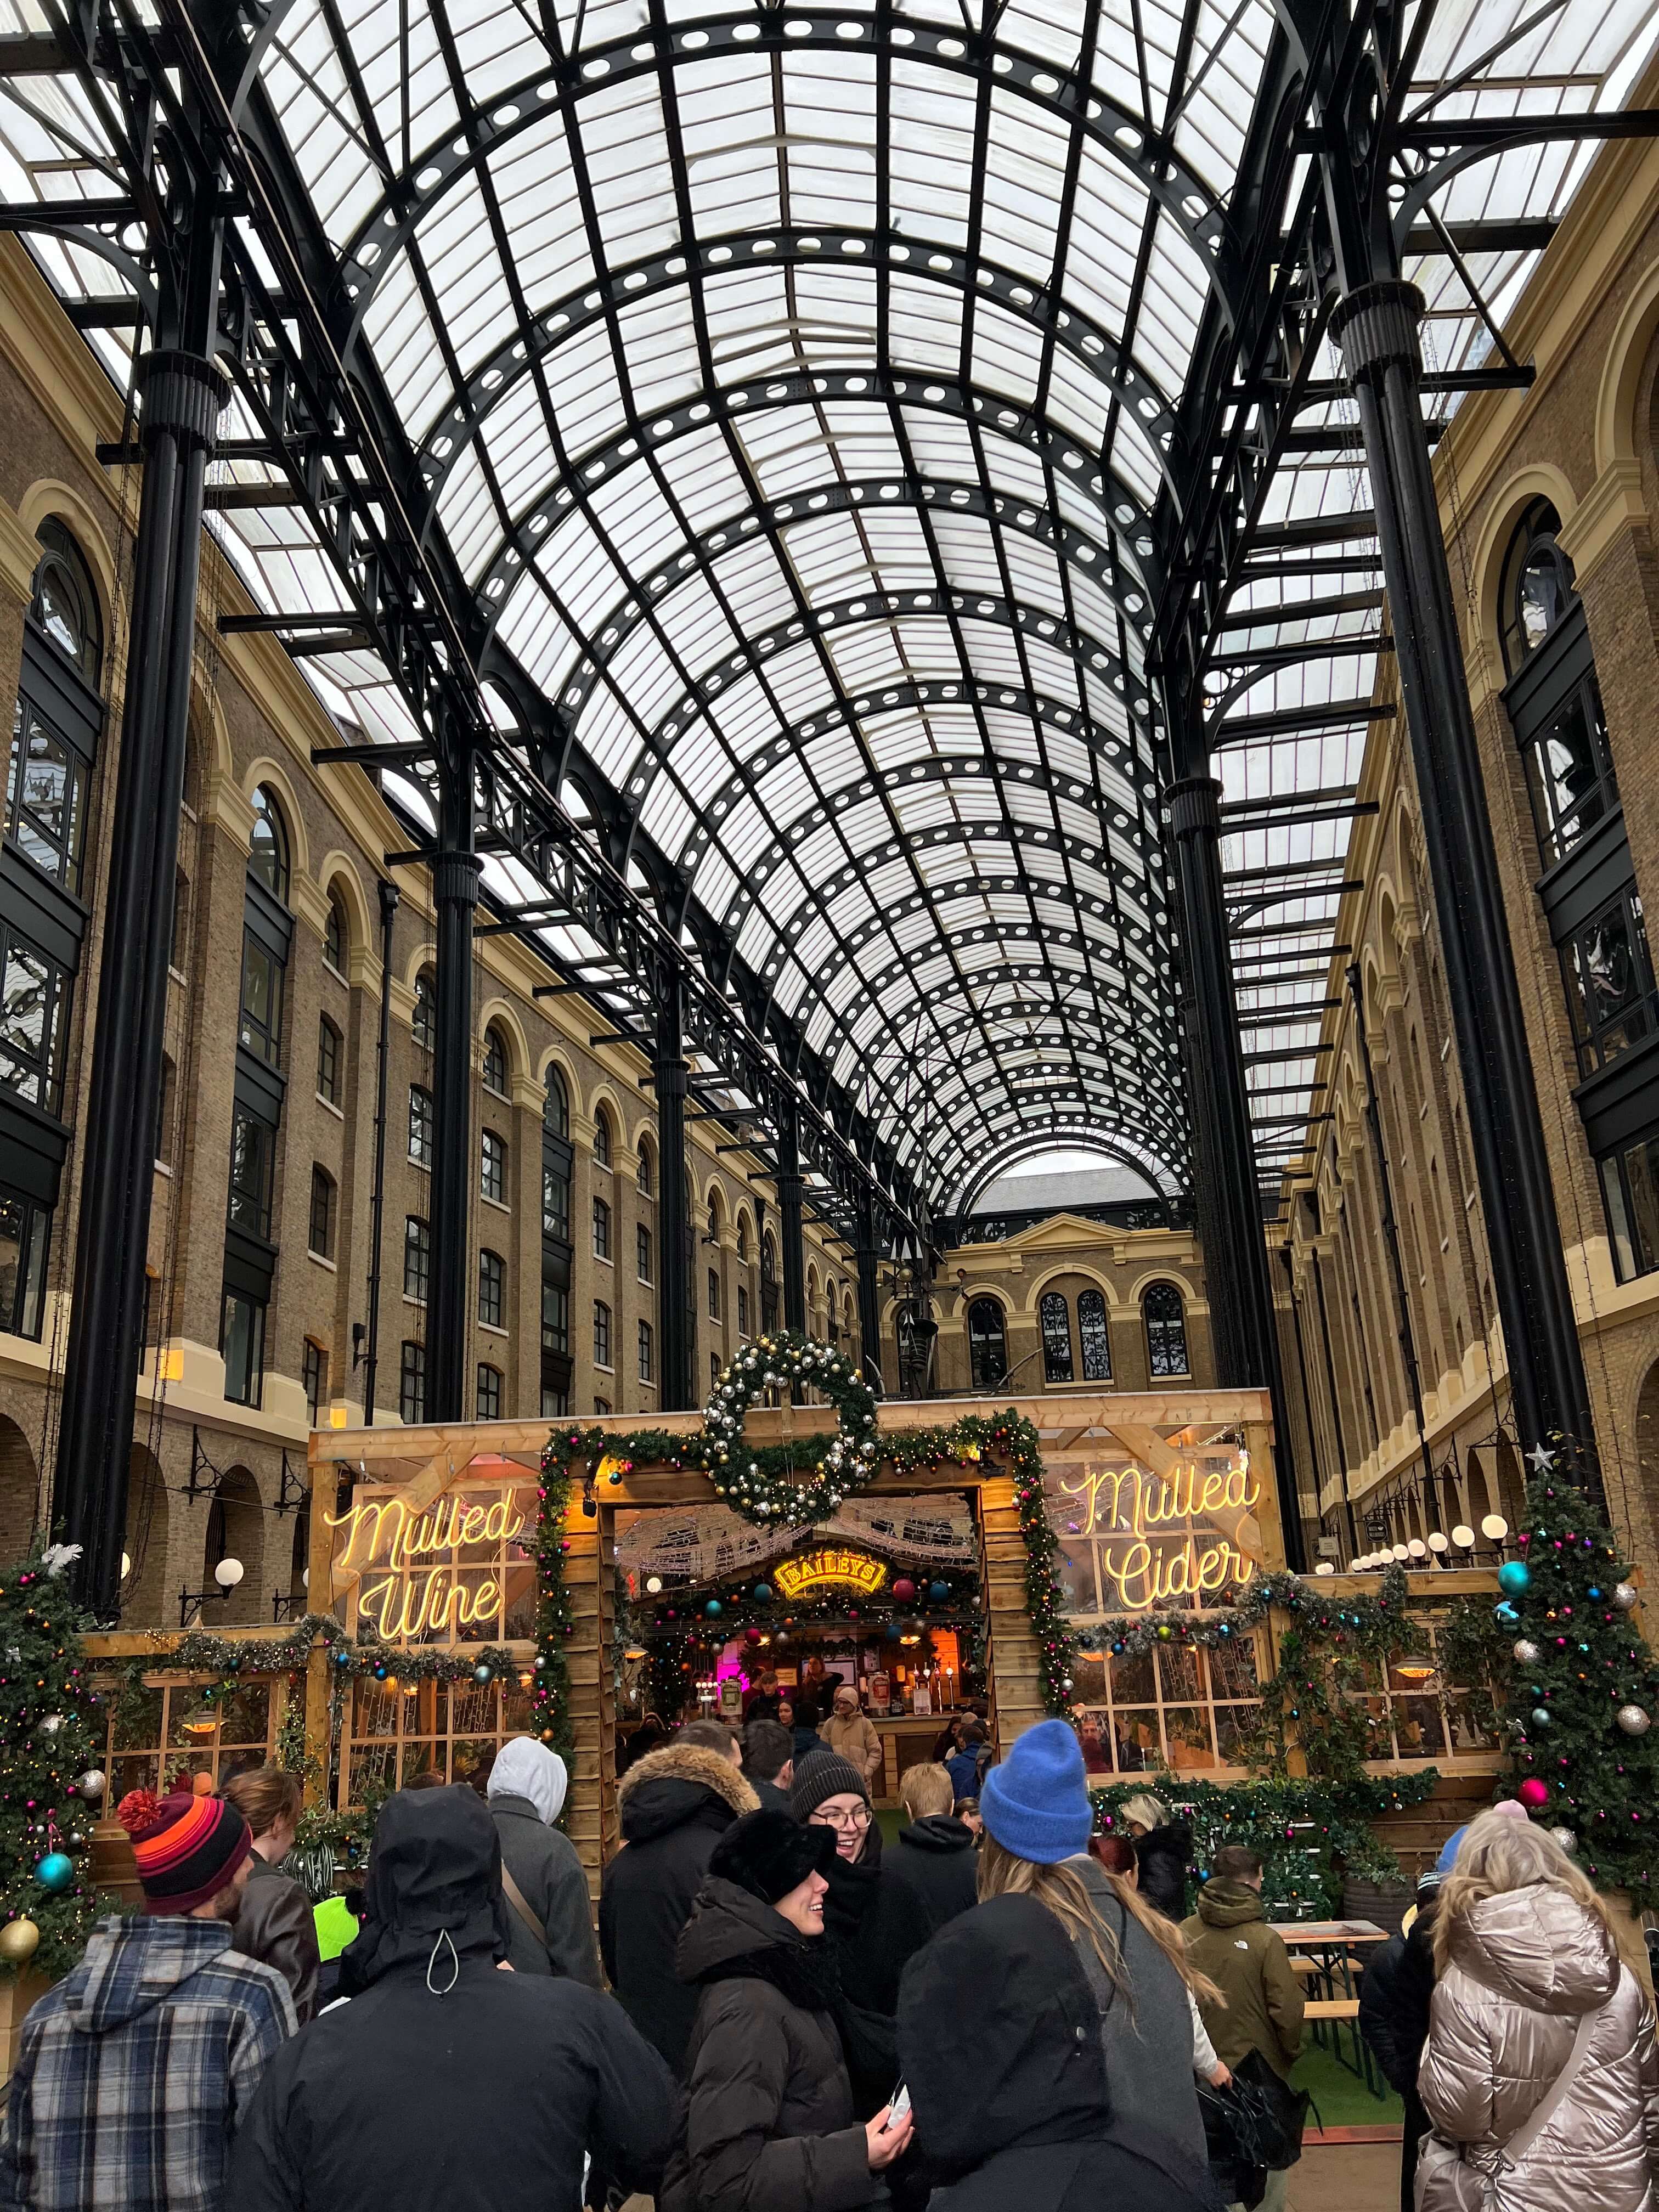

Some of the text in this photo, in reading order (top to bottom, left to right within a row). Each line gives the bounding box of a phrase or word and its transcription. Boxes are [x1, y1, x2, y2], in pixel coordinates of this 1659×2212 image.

[323, 1487, 521, 1572] Mulled
[1060, 1459, 1261, 1540] Mulled
[358, 1566, 501, 1639] Wine
[785, 1556, 876, 1585] BAILEYS
[1104, 1540, 1254, 1609] Cider
